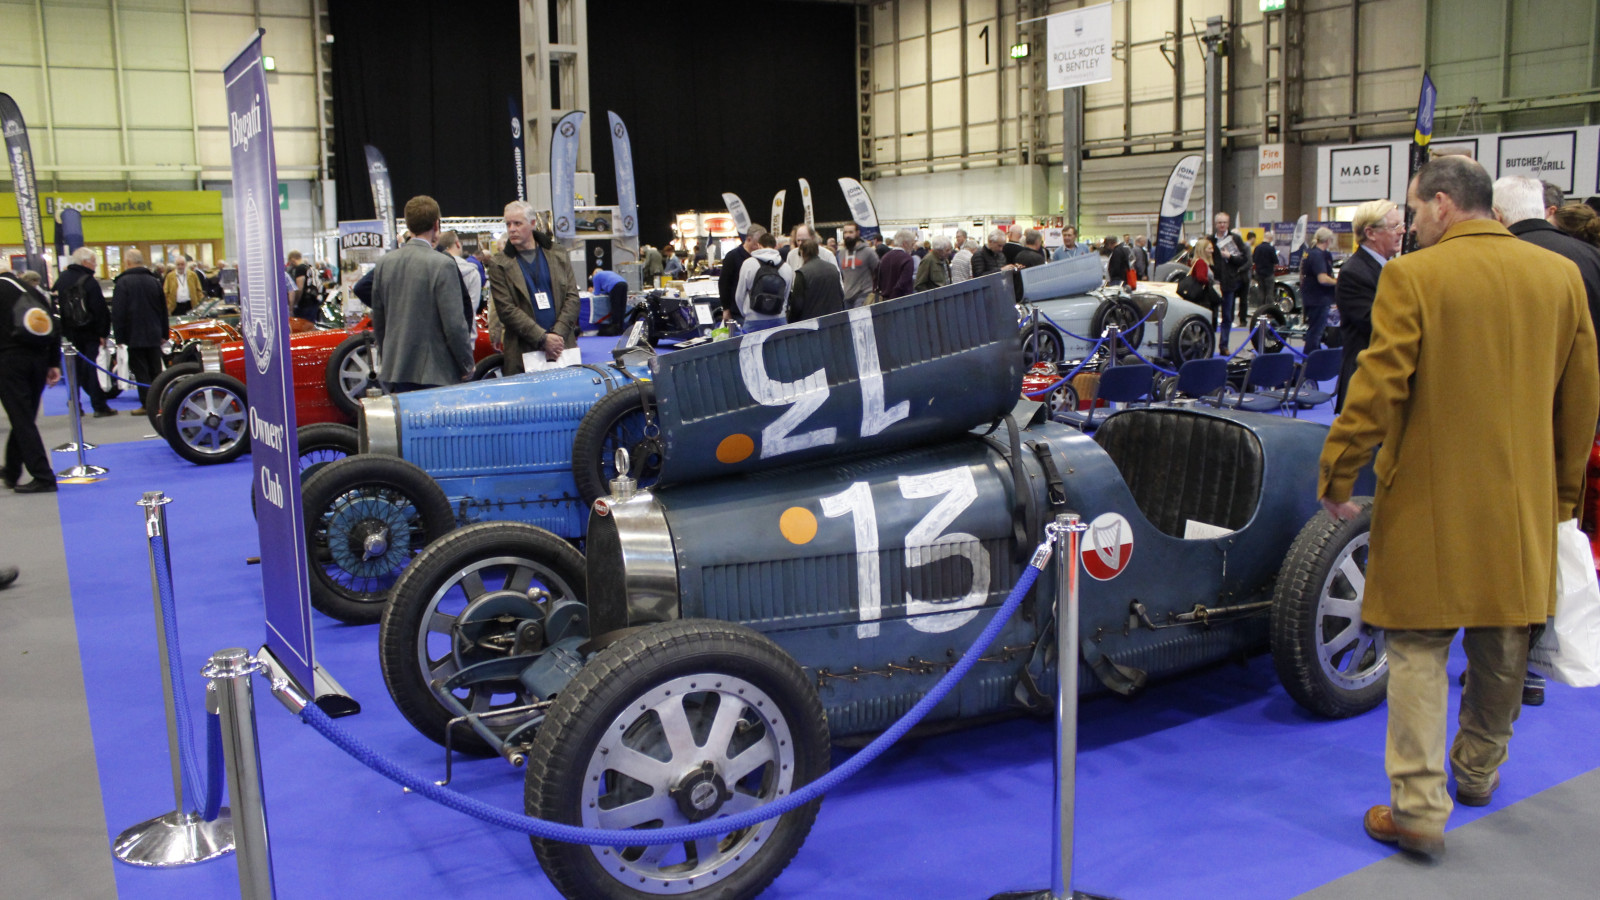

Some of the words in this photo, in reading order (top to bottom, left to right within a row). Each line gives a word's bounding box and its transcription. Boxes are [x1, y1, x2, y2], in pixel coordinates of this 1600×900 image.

[978, 24, 990, 66] 1
[1053, 44, 1106, 63] ROLLS-ROYCE
[1058, 64, 1064, 74] &
[1066, 57, 1100, 73] BENTLEY
[231, 93, 262, 152] Bugatti
[1263, 149, 1280, 158] Fire
[1260, 160, 1282, 172] point
[1506, 156, 1543, 168] BUTCHER
[1541, 160, 1566, 172] GRILL
[1178, 166, 1195, 176] JOIN
[1340, 164, 1380, 177] MADE
[56, 198, 96, 212] food
[98, 199, 153, 211] market
[249, 406, 284, 453] Owners'
[261, 465, 284, 510] Club
[819, 466, 991, 639] 13
